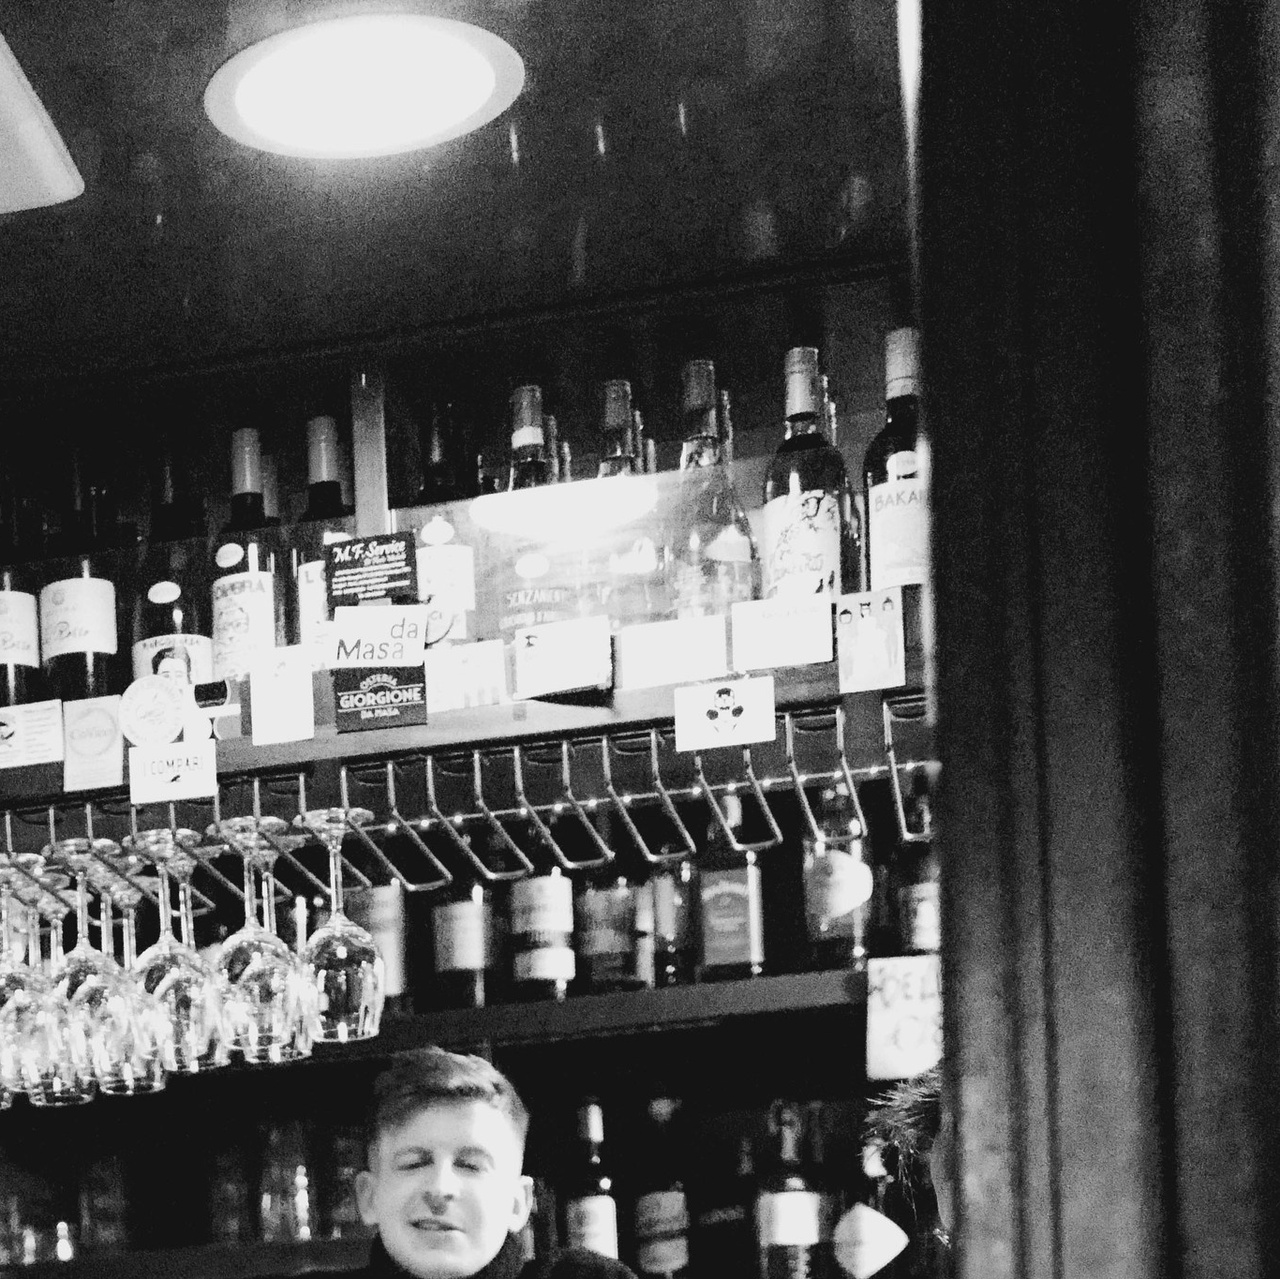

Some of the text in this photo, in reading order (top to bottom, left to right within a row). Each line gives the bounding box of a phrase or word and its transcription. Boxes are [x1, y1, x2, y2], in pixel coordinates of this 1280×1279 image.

[389, 617, 419, 642] da
[335, 637, 406, 662] Masa
[359, 672, 398, 692] OSTERIA
[338, 686, 423, 711] GIORGIONE
